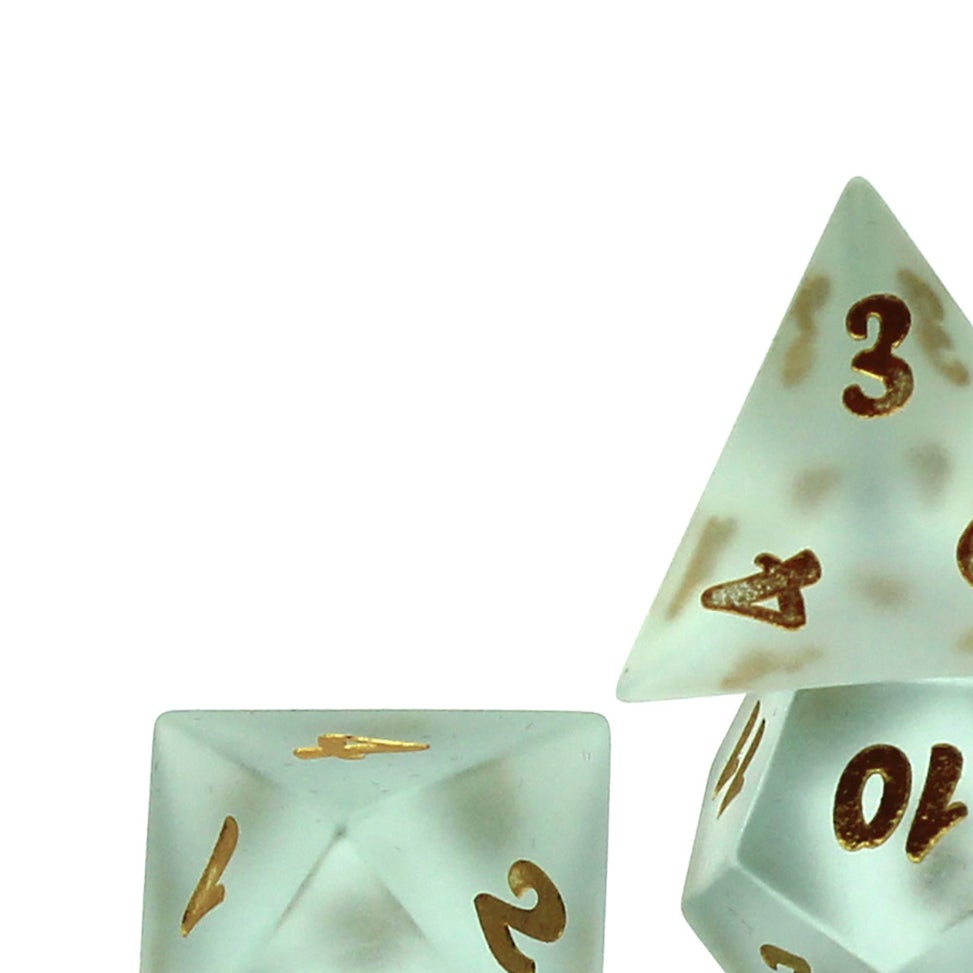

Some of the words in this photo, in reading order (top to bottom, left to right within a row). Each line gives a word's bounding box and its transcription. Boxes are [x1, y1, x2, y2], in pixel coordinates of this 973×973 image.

[842, 293, 915, 419] 3
[700, 549, 822, 631] 4
[833, 743, 968, 864] 10
